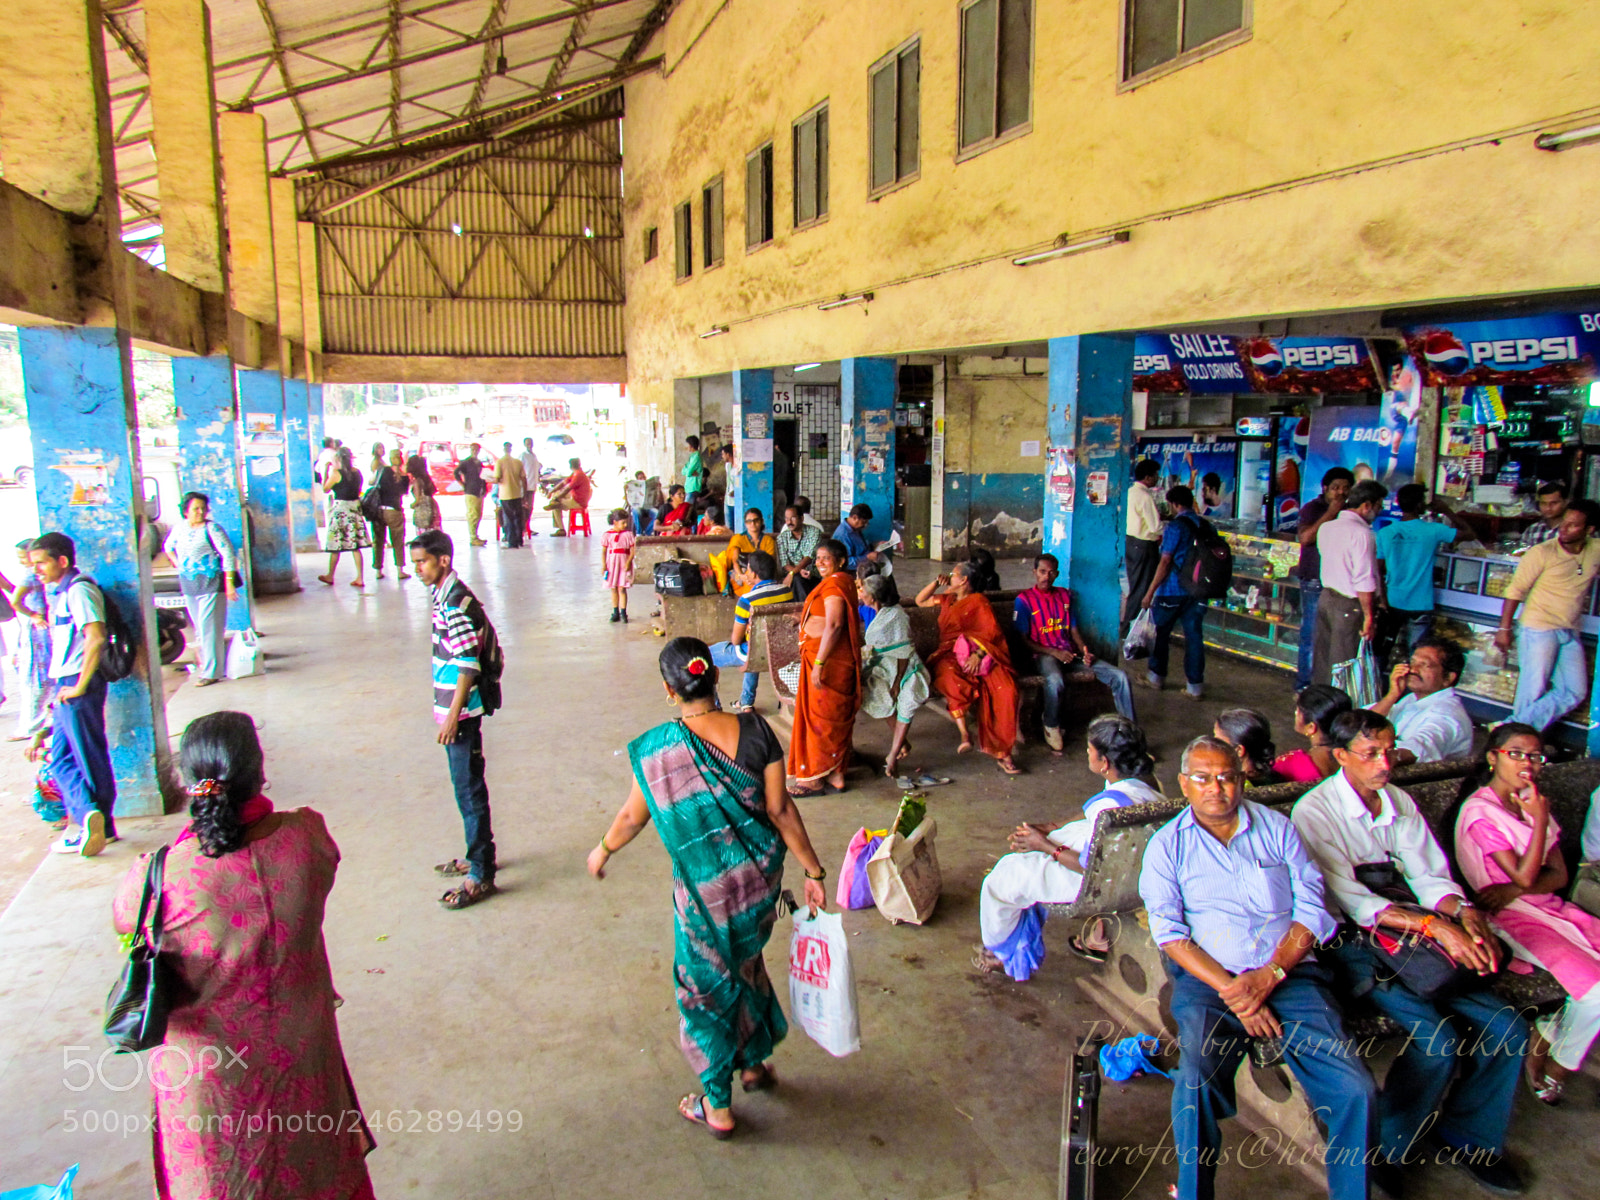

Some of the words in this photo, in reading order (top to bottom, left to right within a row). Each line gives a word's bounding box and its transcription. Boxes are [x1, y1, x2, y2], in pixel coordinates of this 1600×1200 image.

[1169, 333, 1235, 359] SAILEE
[1471, 336, 1578, 364] PEPSI
[1133, 354, 1171, 371] EPSI
[1283, 345, 1358, 367] PEPSI
[1183, 363, 1209, 380] COLD
[1207, 362, 1244, 379] DRINKS
[774, 391, 790, 401] TS
[773, 403, 813, 415] OILET
[1328, 427, 1351, 442] AB
[1352, 427, 1381, 442] BAD
[1143, 444, 1160, 454] AB
[1212, 442, 1236, 453] GAM
